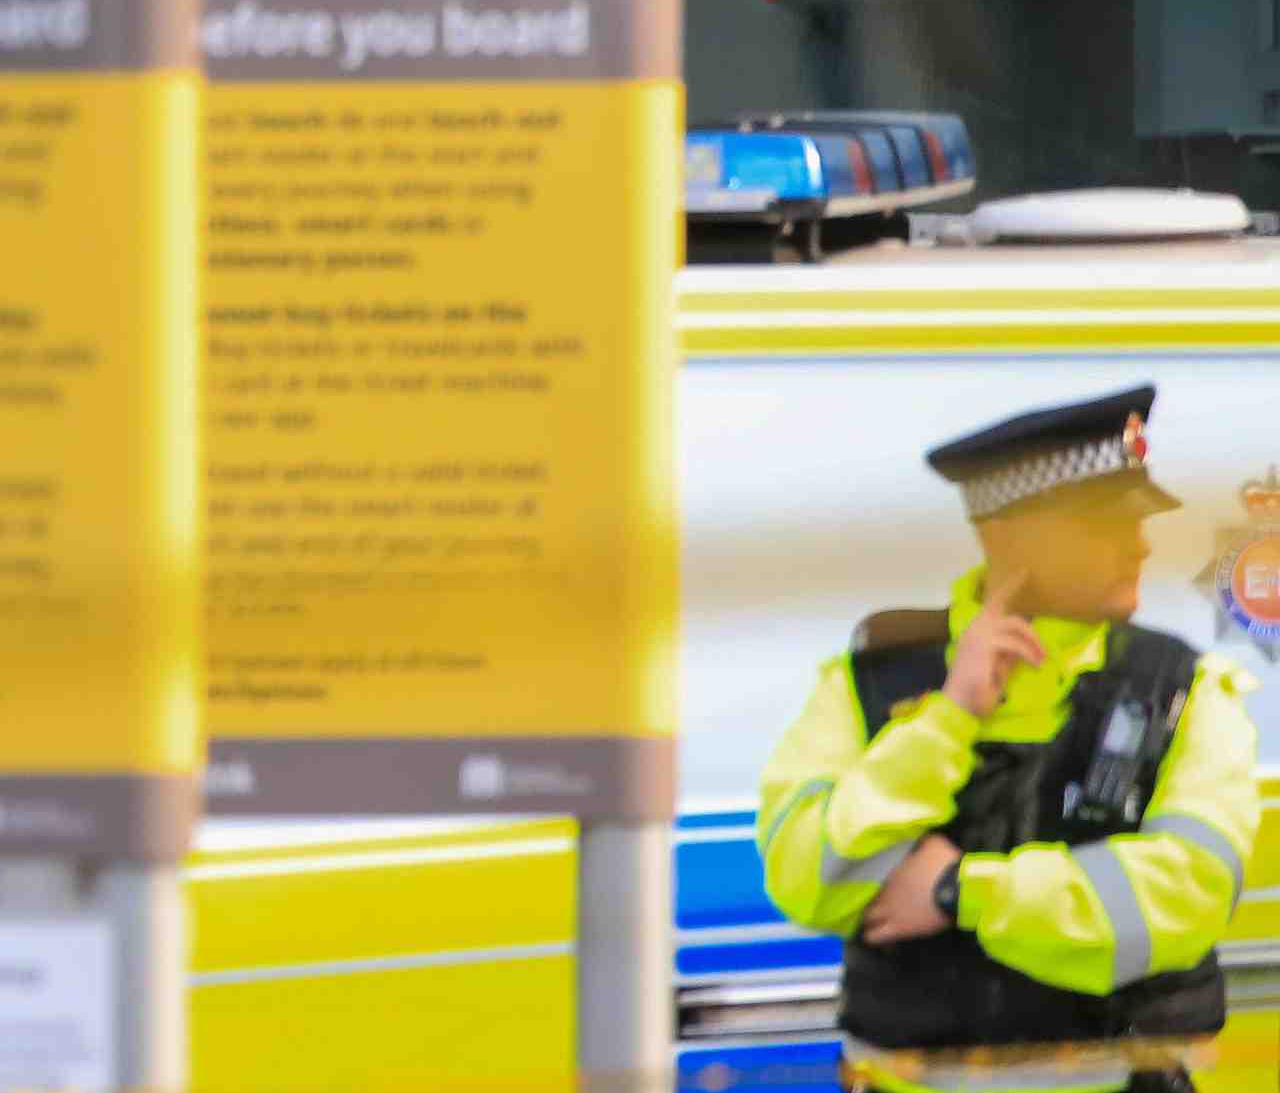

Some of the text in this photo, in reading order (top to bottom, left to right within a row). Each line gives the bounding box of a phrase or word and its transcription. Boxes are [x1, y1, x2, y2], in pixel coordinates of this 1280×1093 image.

[202, 0, 591, 70] efore you board
